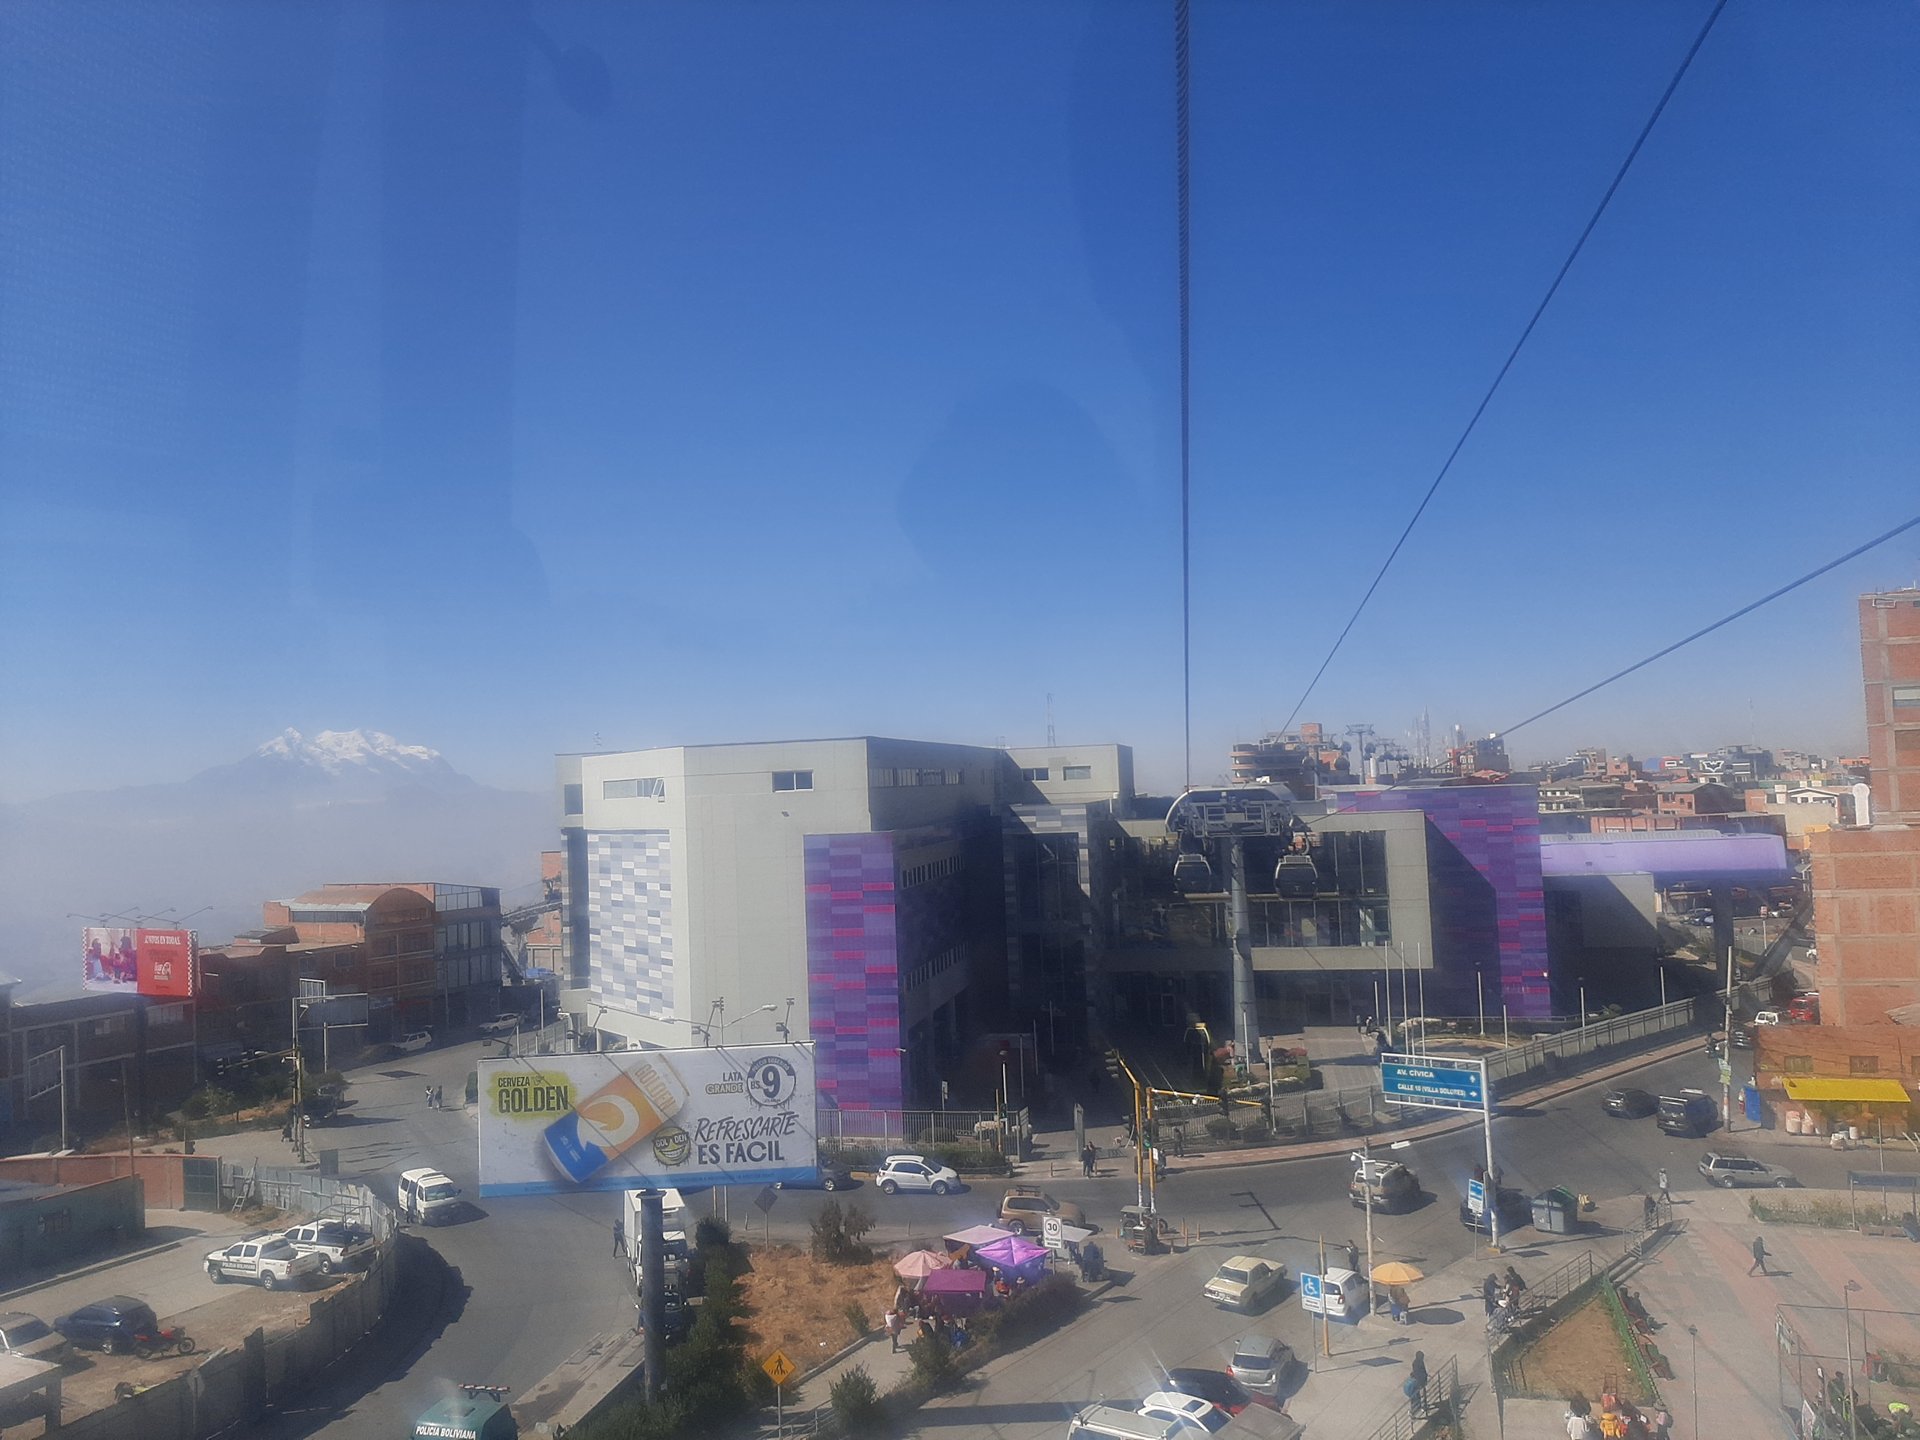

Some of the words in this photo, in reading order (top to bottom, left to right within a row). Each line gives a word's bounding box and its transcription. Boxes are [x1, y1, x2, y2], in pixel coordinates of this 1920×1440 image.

[722, 1071, 743, 1082] LATA
[1396, 1068, 1407, 1076] AV.
[498, 1076, 530, 1088] CERVEZA
[761, 1065, 781, 1099] 9
[1397, 1083, 1414, 1091] CALLE
[706, 1082, 744, 1095] GRANDE
[498, 1085, 569, 1113] GOLDEN
[694, 1111, 799, 1143] REFRESCARTE
[655, 1138, 669, 1148] GOL
[698, 1143, 720, 1165] ES
[725, 1139, 785, 1164] FÁCIL
[1047, 1222, 1058, 1232] 30
[415, 1425, 440, 1436] POLICIA
[440, 1427, 476, 1440] BOLIVIANA
